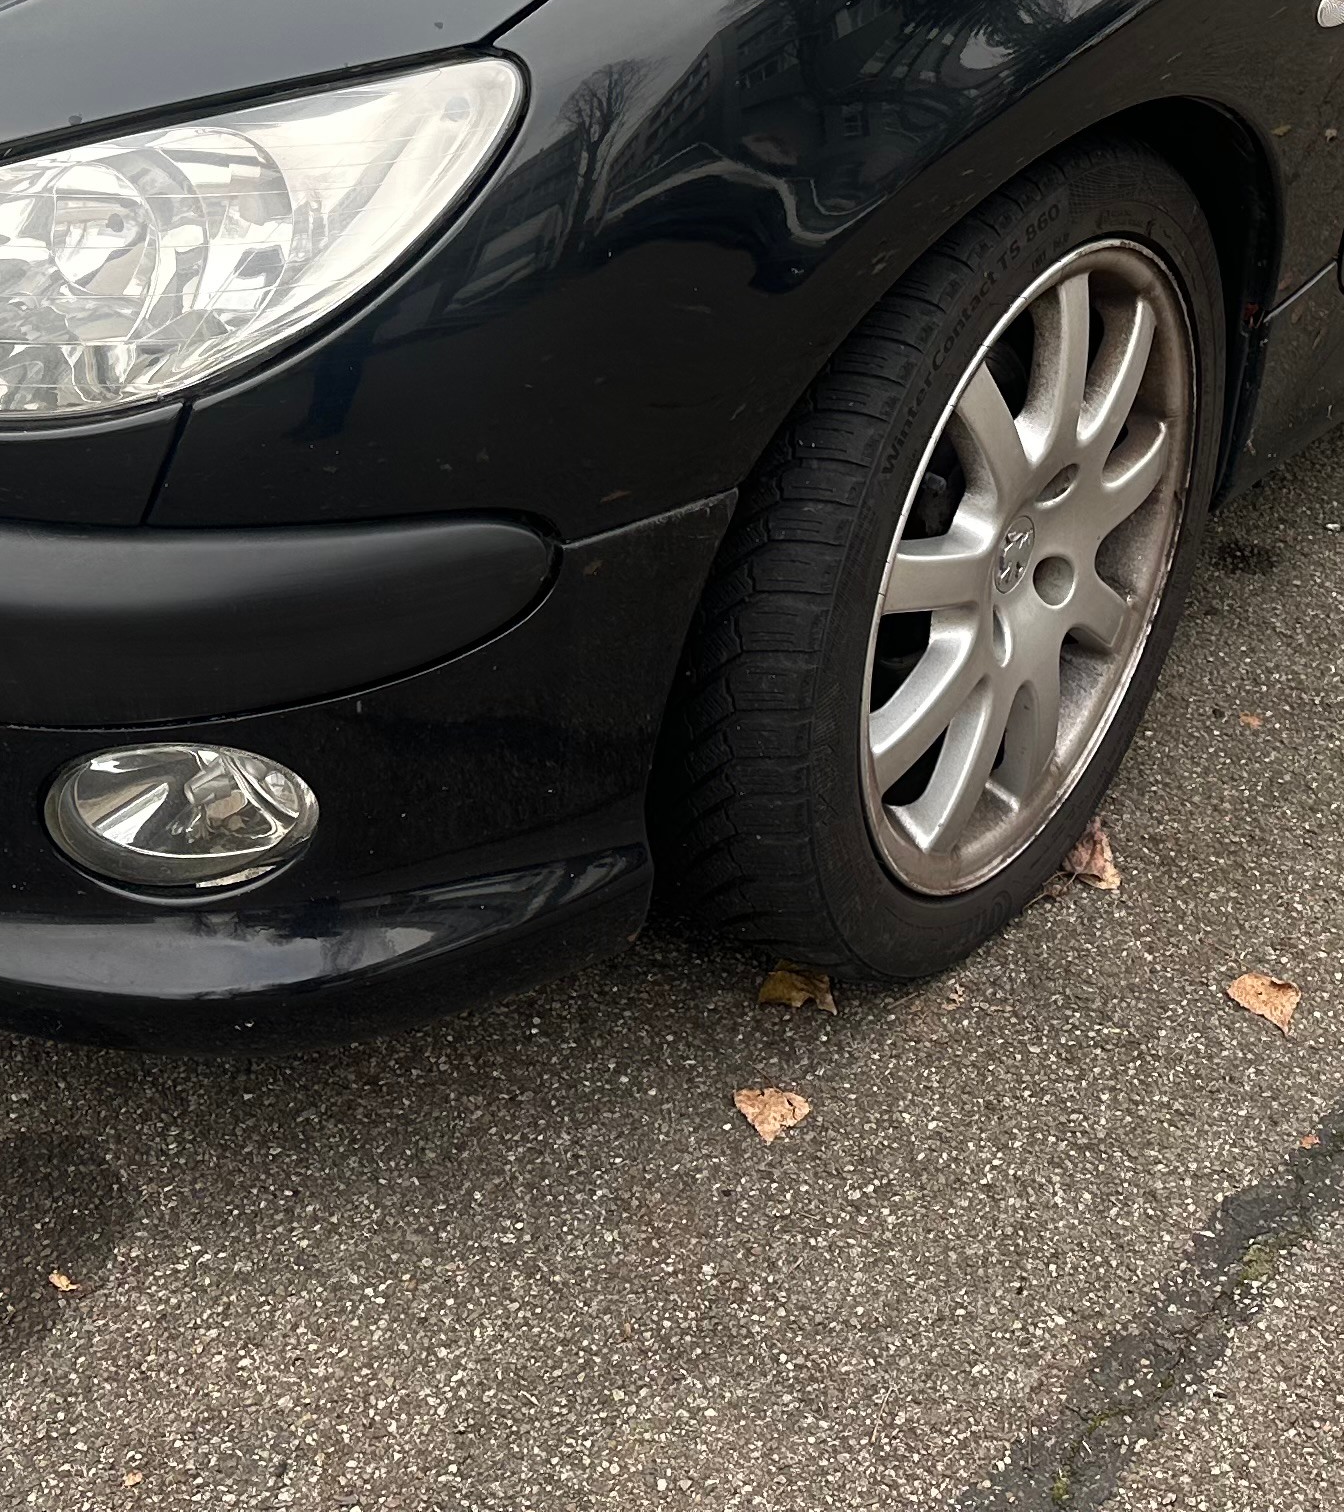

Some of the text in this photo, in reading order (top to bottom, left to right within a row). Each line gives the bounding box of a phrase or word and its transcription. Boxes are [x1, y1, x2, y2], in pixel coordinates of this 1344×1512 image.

[881, 270, 998, 475] WinterContact
[996, 239, 1022, 273] TS
[1025, 203, 1061, 243] 860
